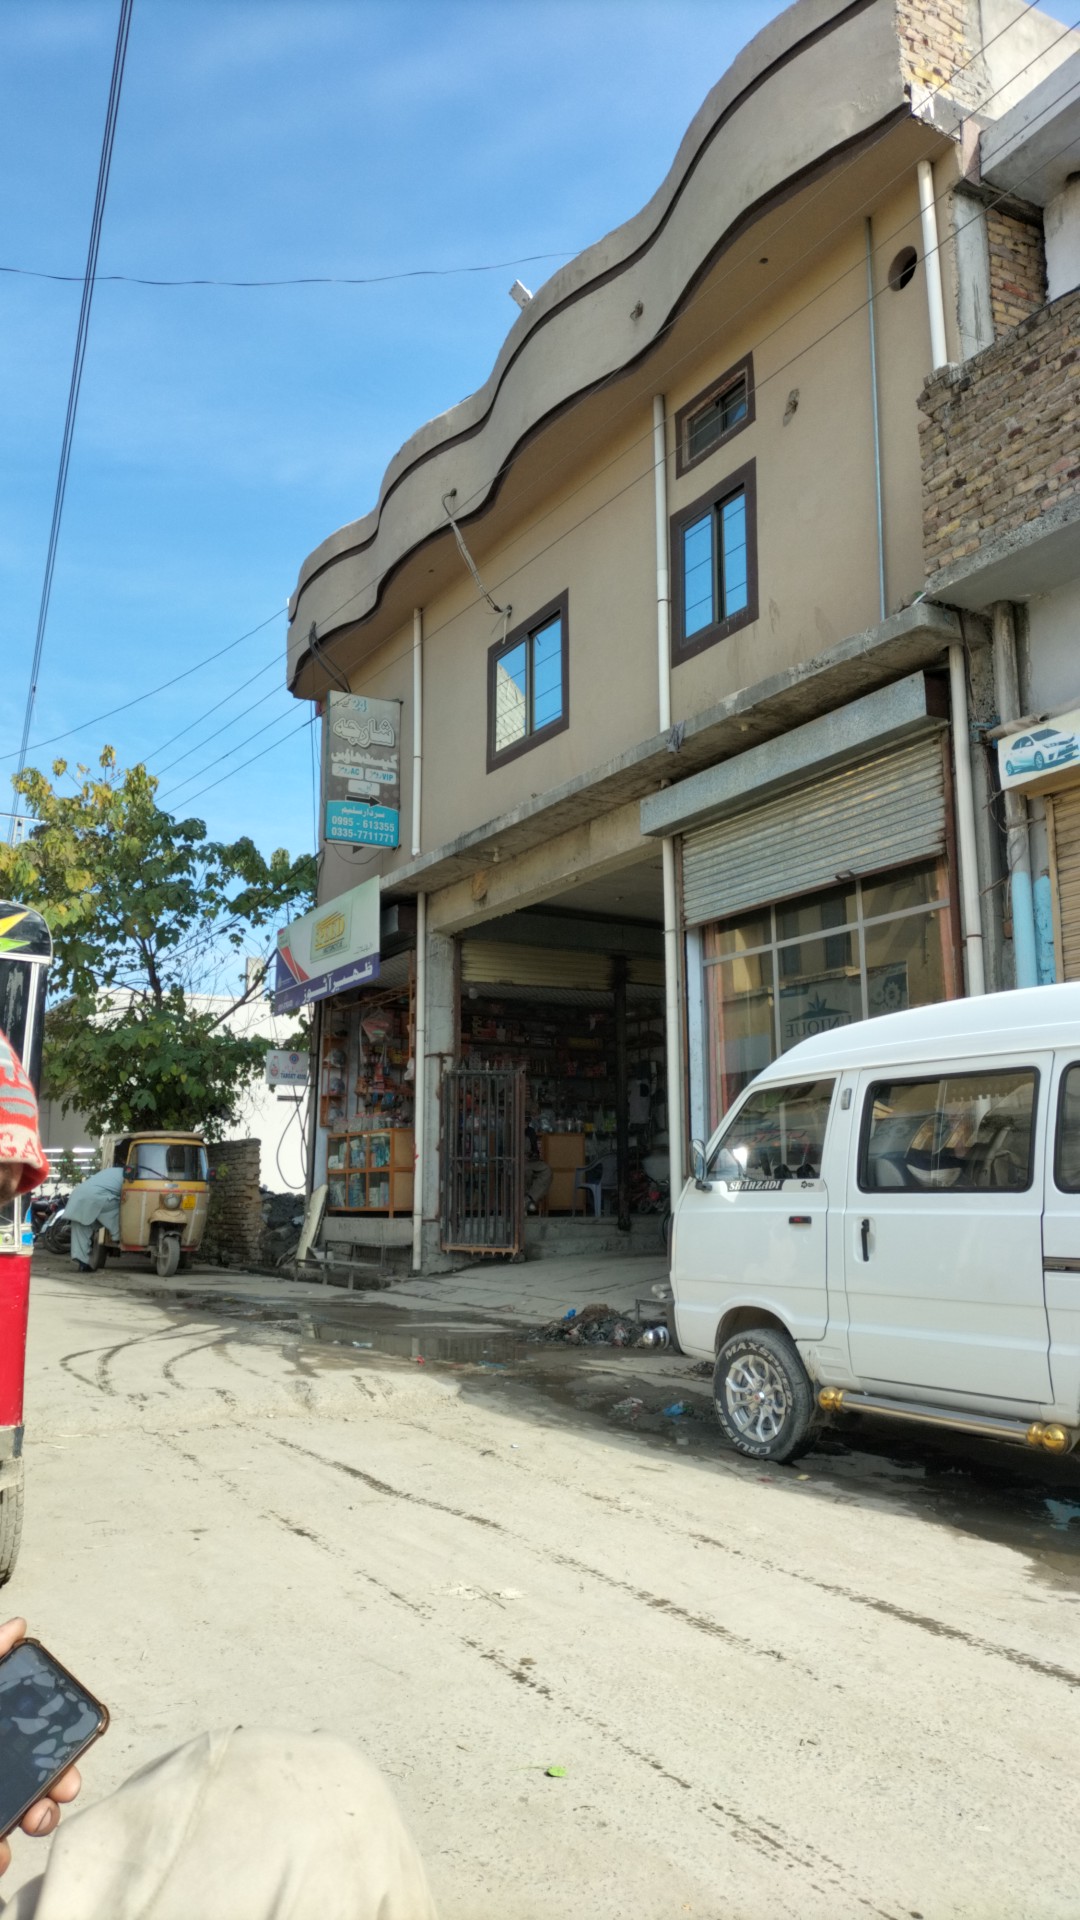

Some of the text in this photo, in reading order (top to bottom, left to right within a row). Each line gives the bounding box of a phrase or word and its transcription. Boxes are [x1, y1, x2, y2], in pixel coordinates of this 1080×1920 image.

[333, 718, 395, 748] شارجہ
[382, 772, 394, 781] VIP
[332, 816, 354, 826] 0995
[363, 820, 395, 832] 613355
[332, 827, 394, 843] 0335-7711771
[728, 1180, 780, 1191] SHAHZADI
